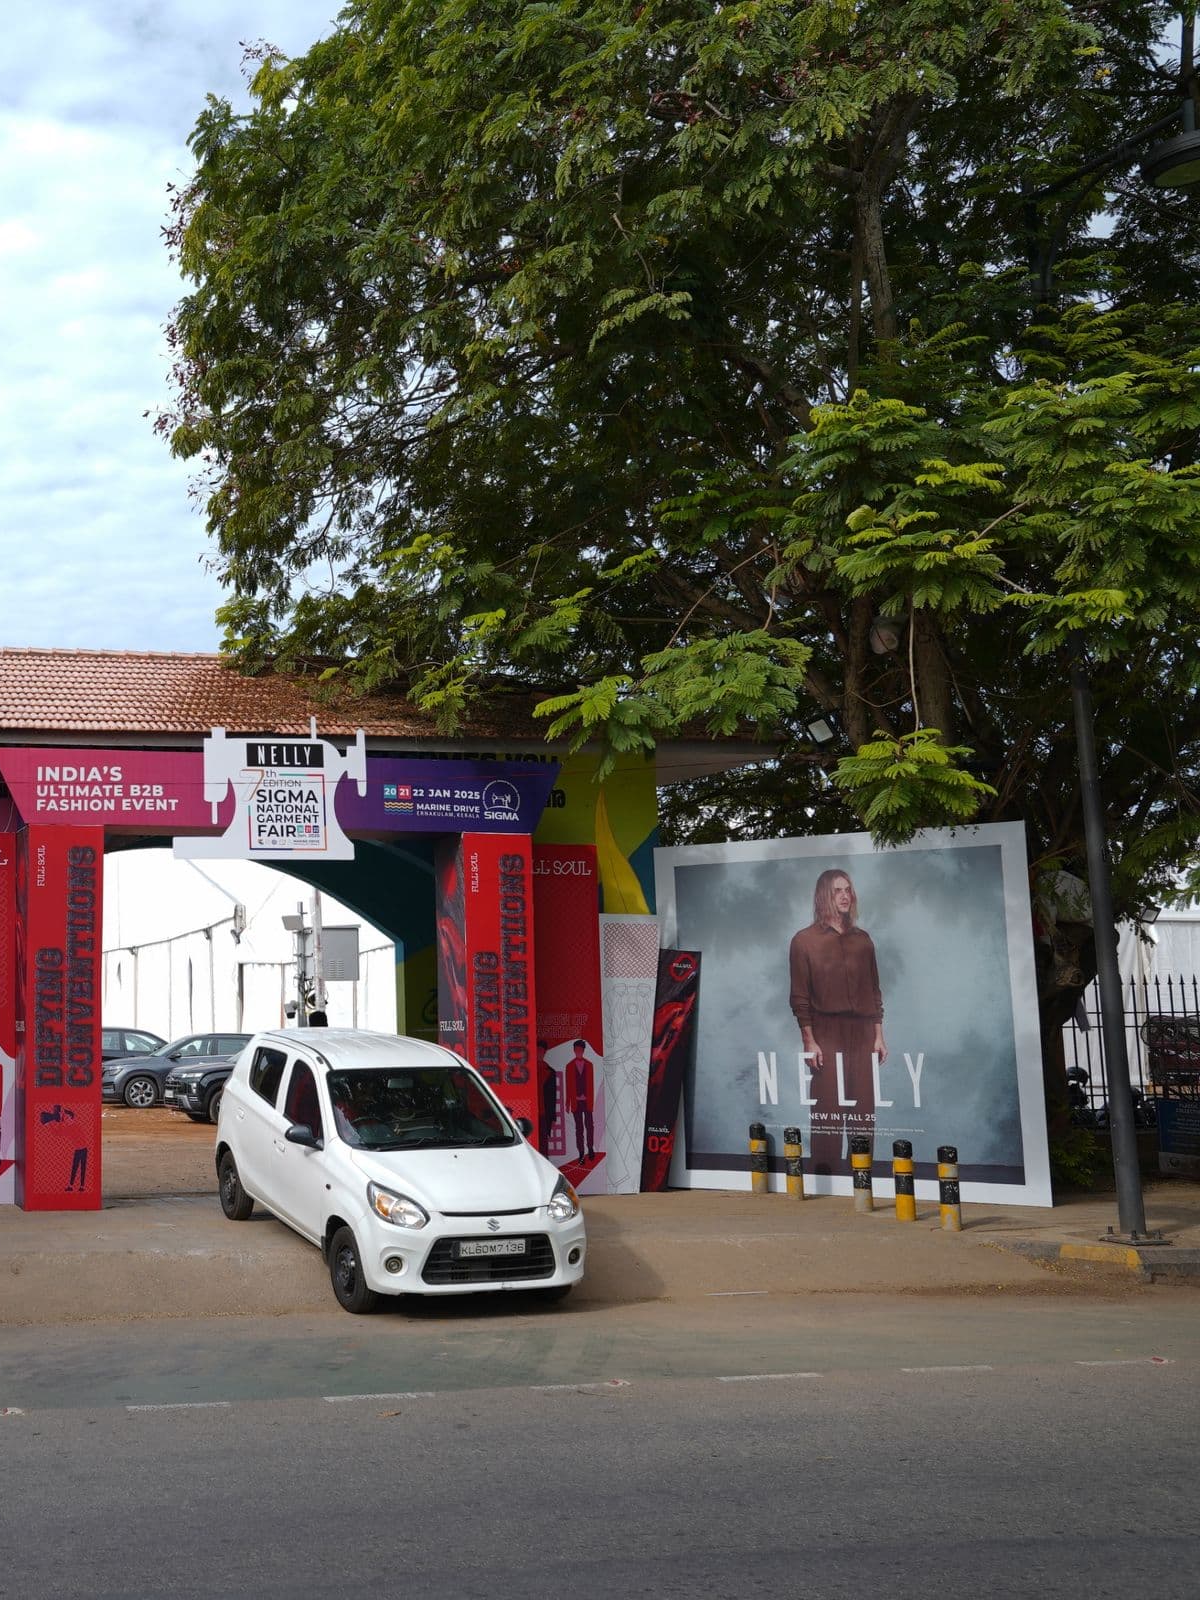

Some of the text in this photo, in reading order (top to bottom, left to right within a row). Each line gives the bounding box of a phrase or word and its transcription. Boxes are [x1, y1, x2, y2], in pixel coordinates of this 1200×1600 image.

[258, 745, 311, 766] NELLY
[36, 766, 123, 782] INDIA'S
[263, 779, 301, 787] EDITION
[36, 784, 164, 797] ULTIMATE B2B
[256, 789, 318, 804] SIGMA
[384, 787, 480, 800] 20 21 22 JAN 2025
[36, 799, 178, 811] FASHION EVENT
[256, 804, 319, 814] NATIONAL
[416, 803, 480, 813] MARINE DRIVE
[256, 814, 319, 824] GARMENT
[484, 811, 519, 821] SIGMA
[258, 825, 297, 837] FAIR
[34, 947, 63, 1088] DEFYING
[473, 951, 501, 1084] DEFYING
[757, 1052, 925, 1108] NELLY
[808, 1112, 877, 1122] NEW IN FALL 25
[648, 1135, 670, 1153] 02
